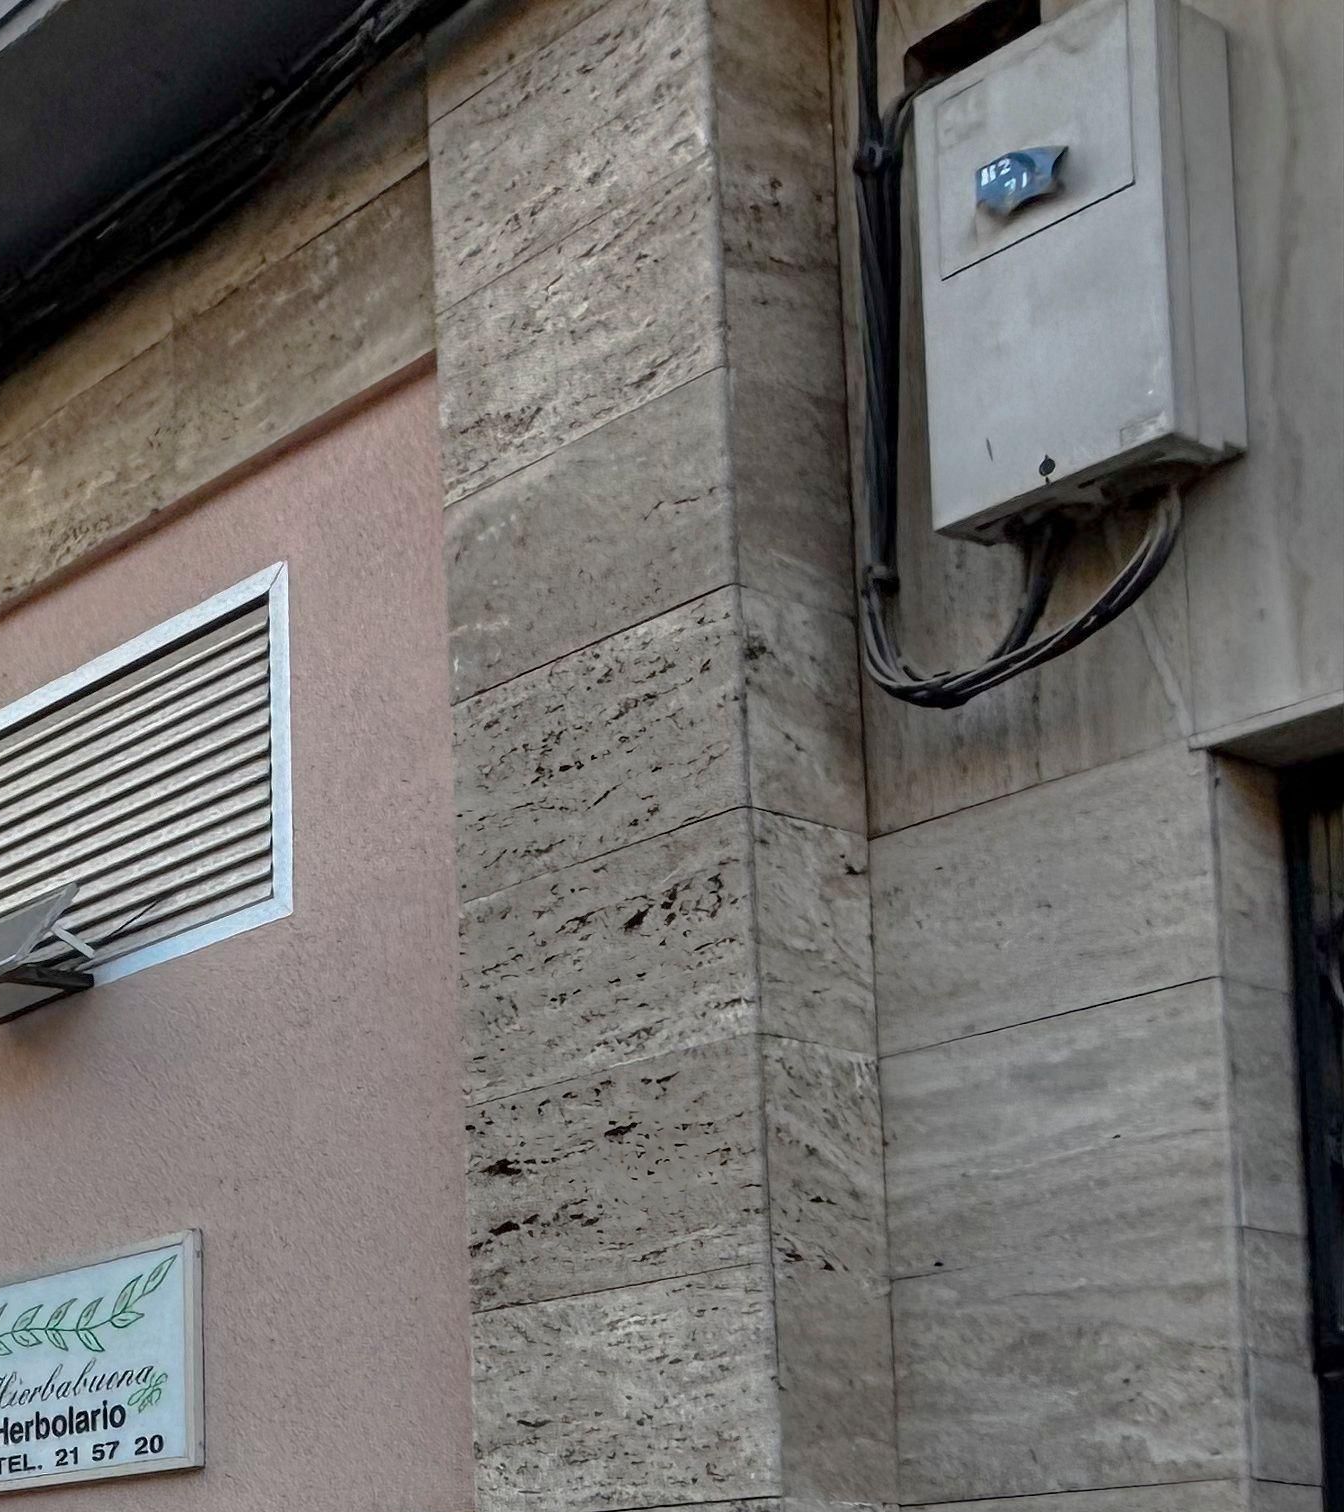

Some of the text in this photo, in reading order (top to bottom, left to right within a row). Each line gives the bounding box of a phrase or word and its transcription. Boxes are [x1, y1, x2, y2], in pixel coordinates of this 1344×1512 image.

[55, 1446, 79, 1467] 21
[91, 1440, 120, 1461] 57
[134, 1434, 164, 1456] 20
